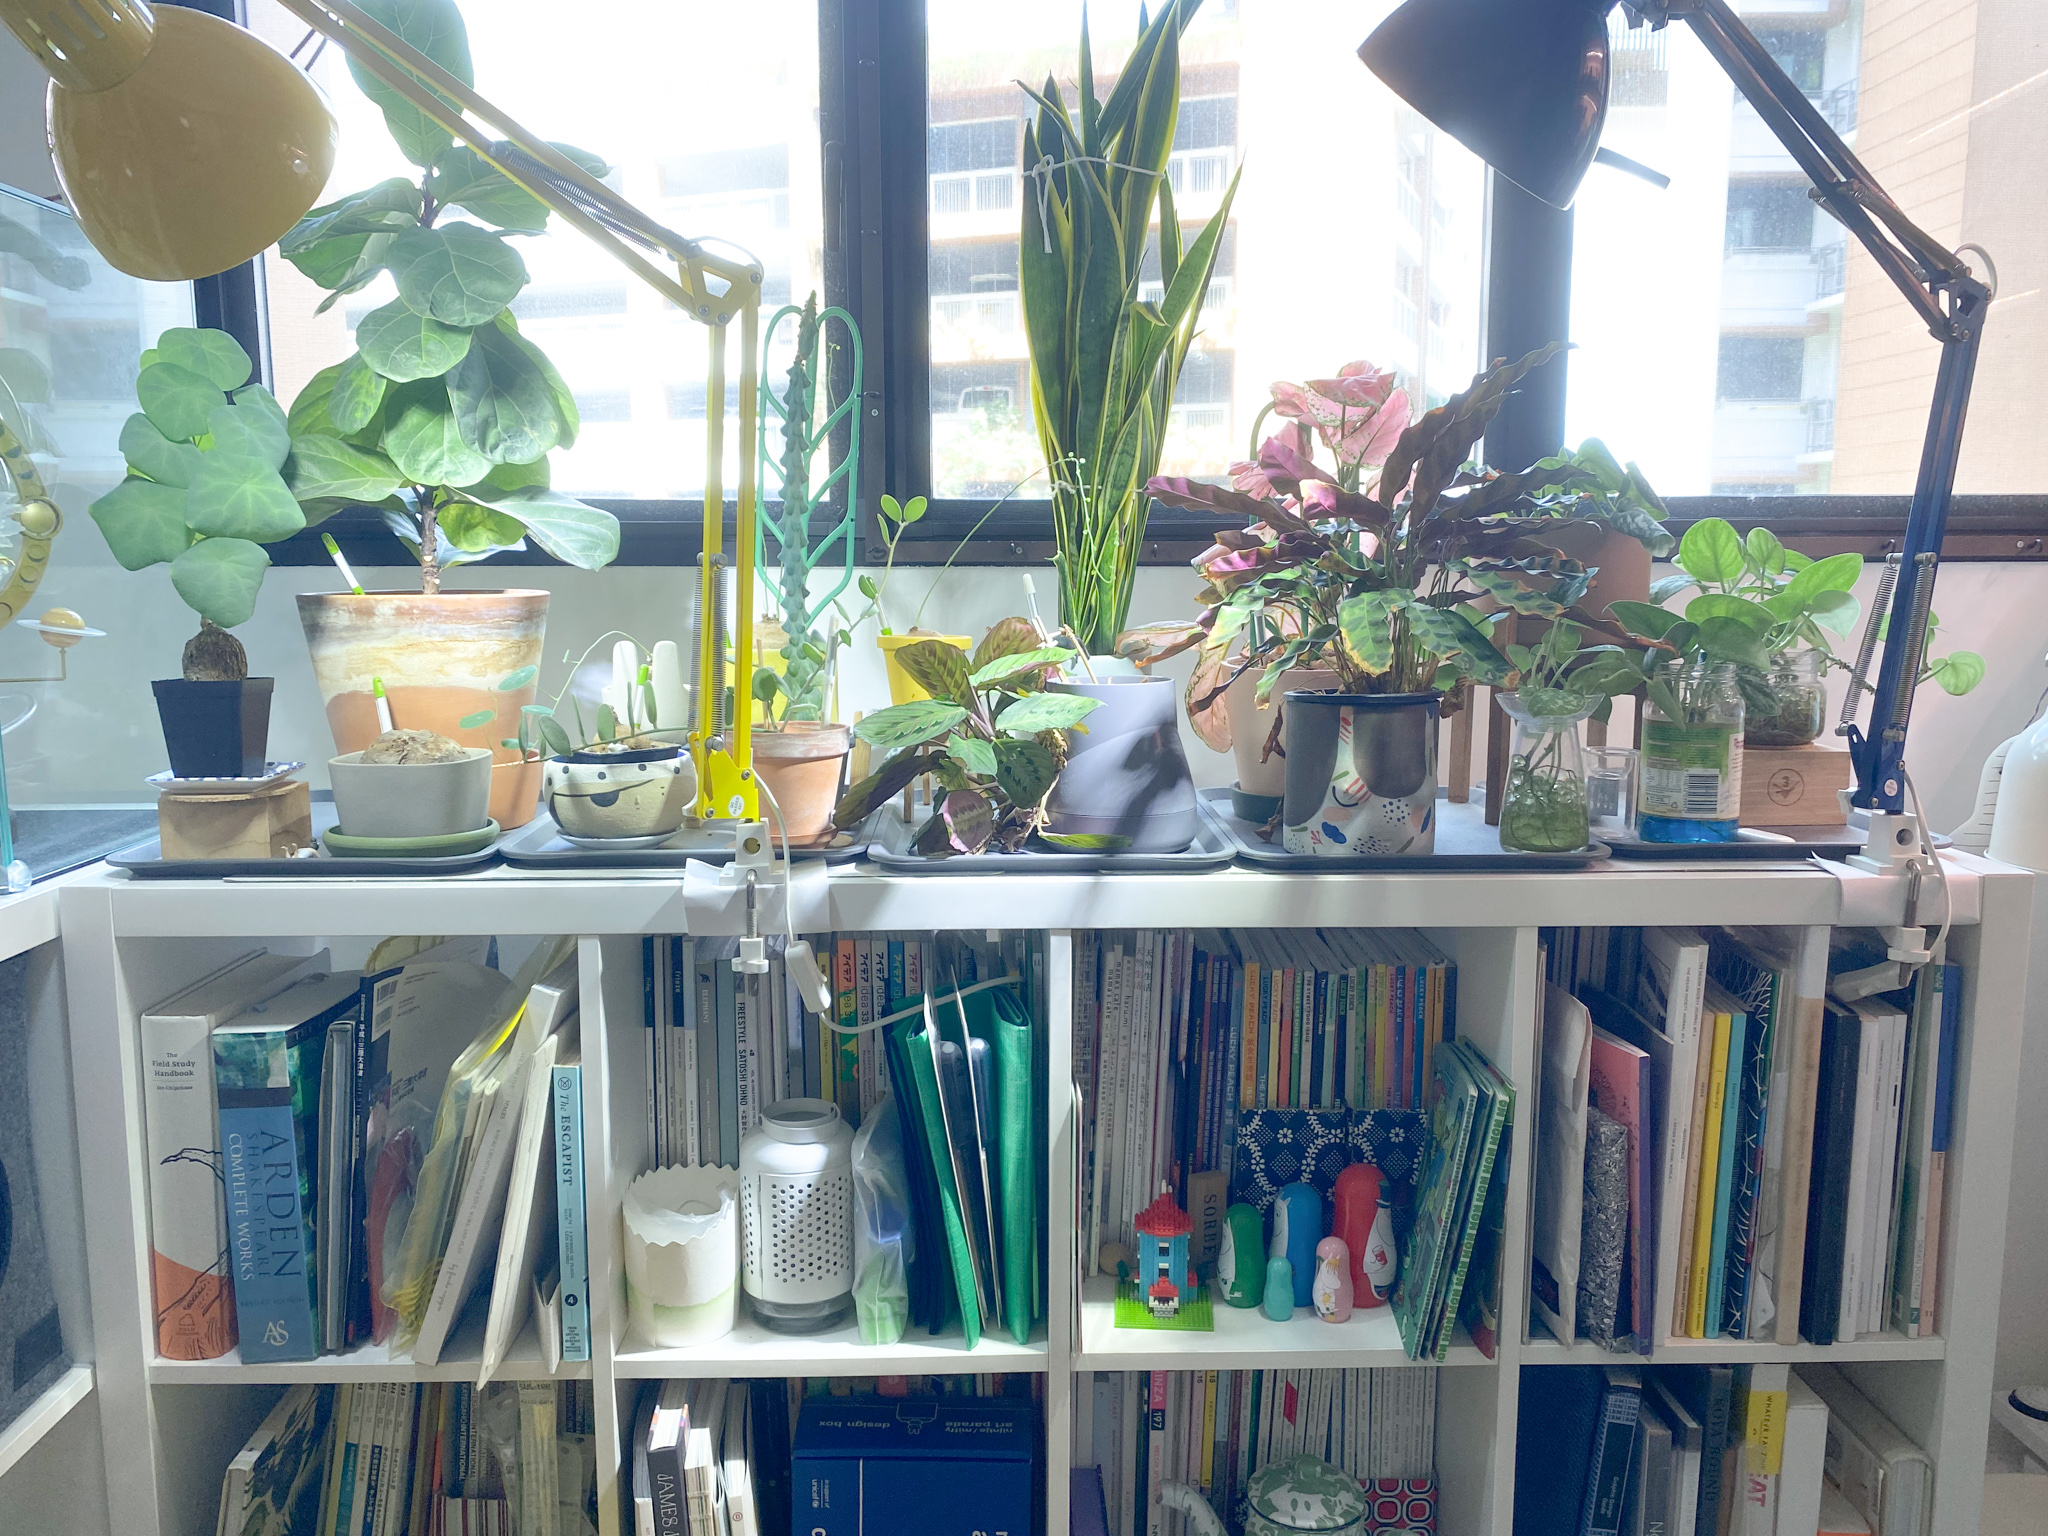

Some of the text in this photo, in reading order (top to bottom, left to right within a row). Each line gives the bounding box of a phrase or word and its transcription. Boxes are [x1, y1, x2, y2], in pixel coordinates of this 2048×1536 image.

[674, 970, 682, 993] frieze
[843, 953, 853, 1008] アイデア idea
[860, 953, 871, 1008] アイデア idea
[876, 952, 885, 1008] アイデア idea
[893, 953, 902, 1002] アイデア ide
[909, 953, 918, 983] アイデア
[1106, 969, 1114, 998] mamas
[1114, 961, 1122, 990] mamas
[172, 1060, 196, 1068] Study
[737, 1002, 748, 1106] FREESTYLE SATOSHI OHNO
[1227, 1026, 1238, 1102] LUCKY PEACH
[500, 1100, 510, 1119] SPACES
[482, 1148, 495, 1175] CREATIVE
[560, 1094, 573, 1187] The ESCAPIST
[228, 1133, 255, 1281] COMPLETE WORKS
[246, 1133, 271, 1279] SHAKESPEARE
[259, 1129, 302, 1278] ARDEN
[476, 1176, 486, 1195] PEOPLE
[1203, 1194, 1217, 1256] SORBE
[1443, 1099, 1507, 1342] OM NOM NOM NOM NOM NOM NOM NOM NOM
[1912, 1311, 1919, 1320] 7
[819, 1420, 891, 1429] design box
[945, 1420, 992, 1428] parade
[1153, 1411, 1162, 1429] 197
[459, 1424, 468, 1481] INTERNATIONAL
[470, 1423, 478, 1480] INTERNATIONAL
[1705, 1397, 1724, 1501] KOYA BOUND
[657, 1473, 679, 1528] JAMES
[812, 1479, 820, 1499] unicef
[1607, 1476, 1620, 1519] Graphic Design
